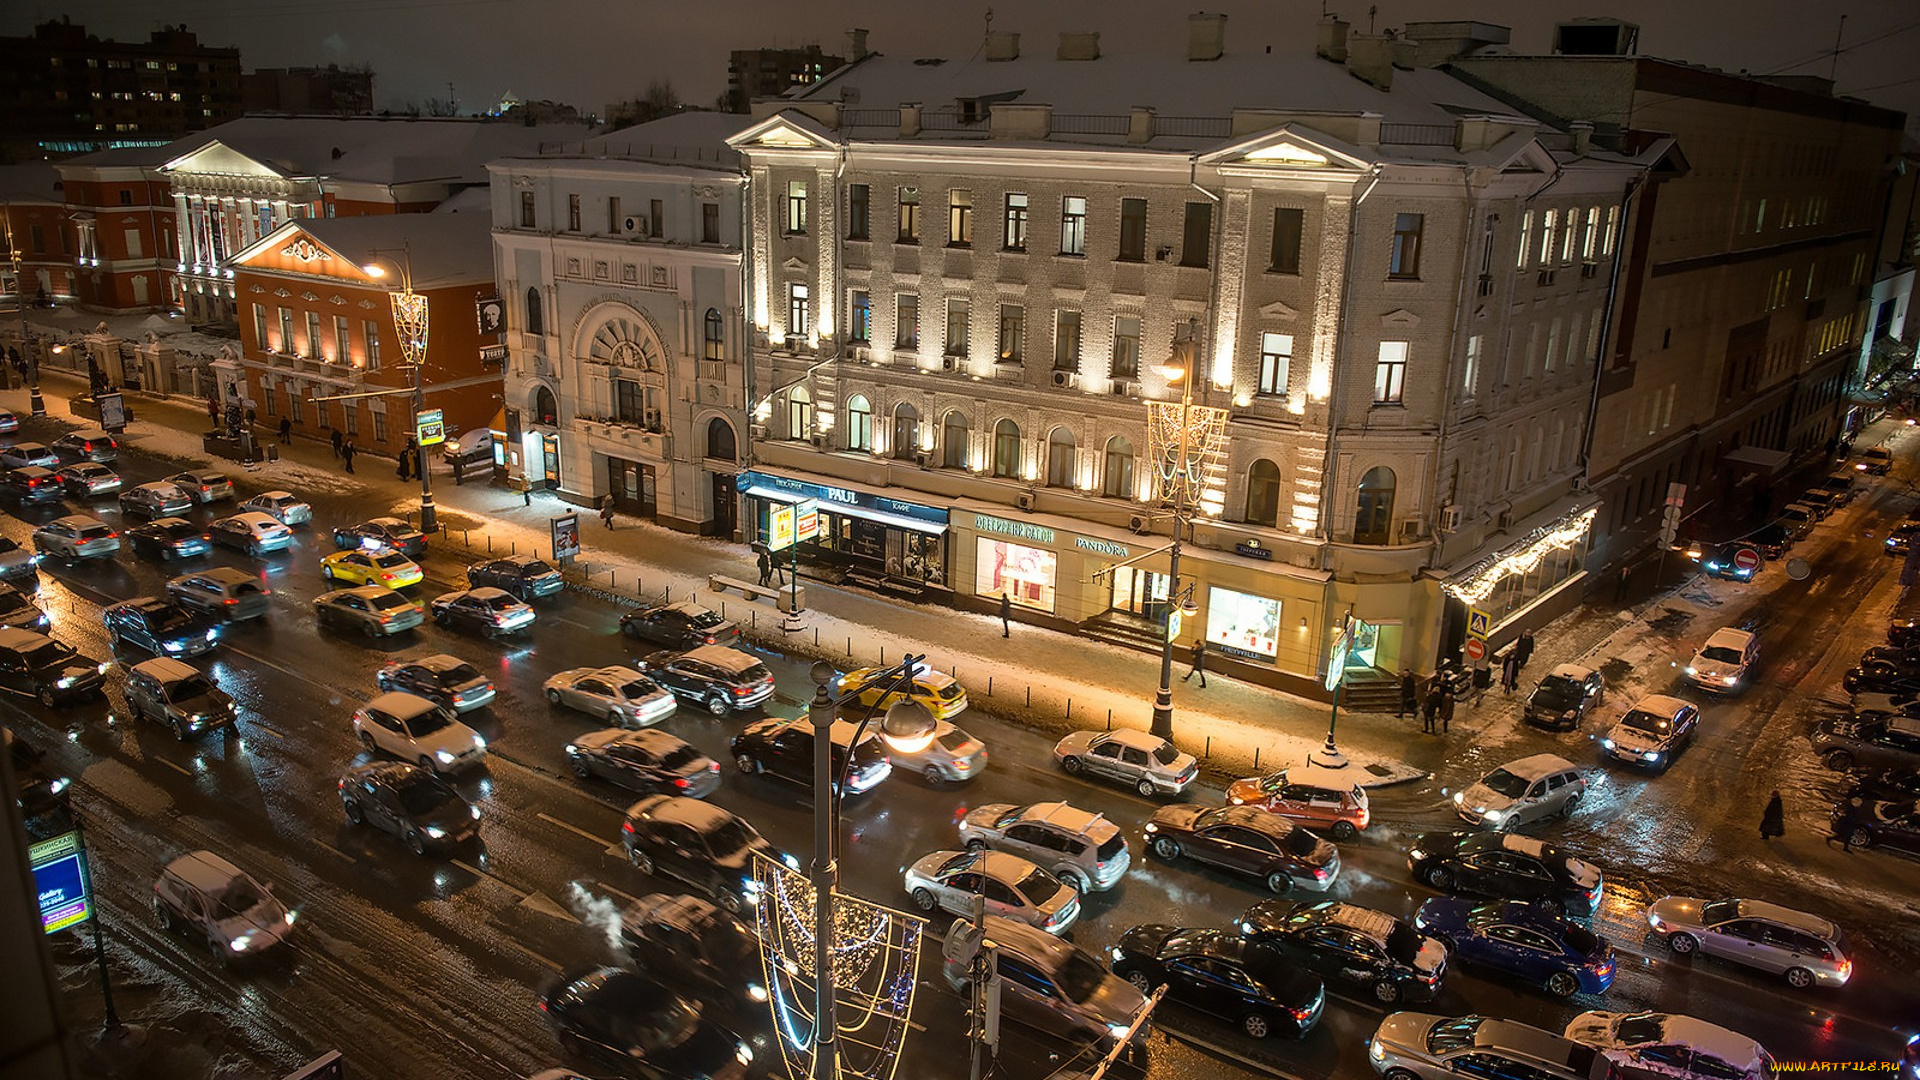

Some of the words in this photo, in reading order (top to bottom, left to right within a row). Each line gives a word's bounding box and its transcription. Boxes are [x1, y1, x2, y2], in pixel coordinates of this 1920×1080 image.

[828, 488, 859, 504] PAUL
[1025, 526, 1055, 543] САЛОН
[1075, 537, 1128, 557] PANDORA
[29, 836, 73, 853] УШКИНСКАЯ
[38, 888, 63, 901] Gallery
